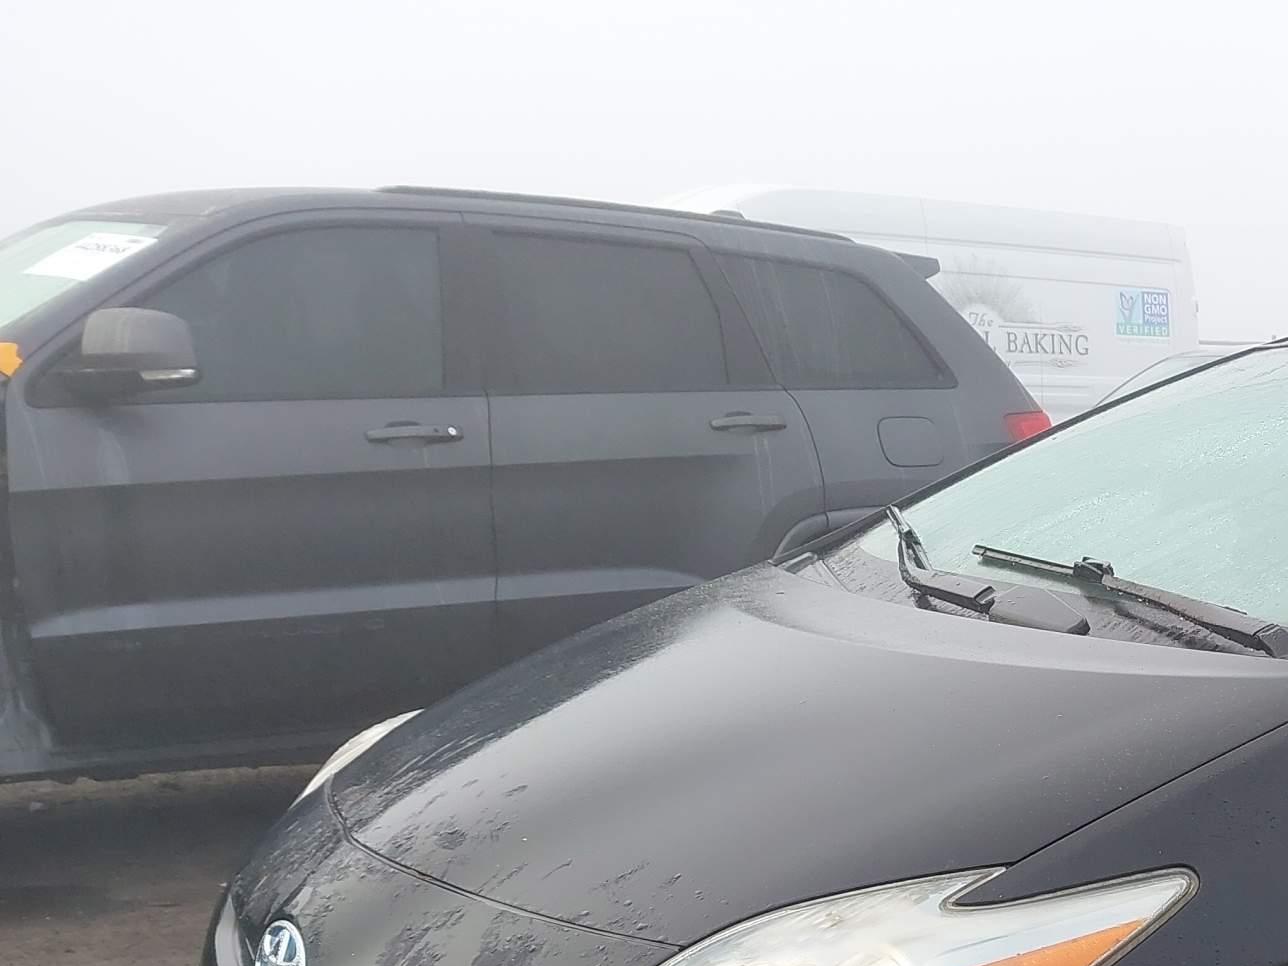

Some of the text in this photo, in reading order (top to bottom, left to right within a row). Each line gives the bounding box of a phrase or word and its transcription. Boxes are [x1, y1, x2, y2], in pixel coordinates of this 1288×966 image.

[1143, 293, 1168, 305] NON
[1143, 304, 1168, 316] GMO
[968, 312, 994, 328] The
[1118, 324, 1168, 337] VERIFIED
[1006, 331, 1089, 356] BAKING
